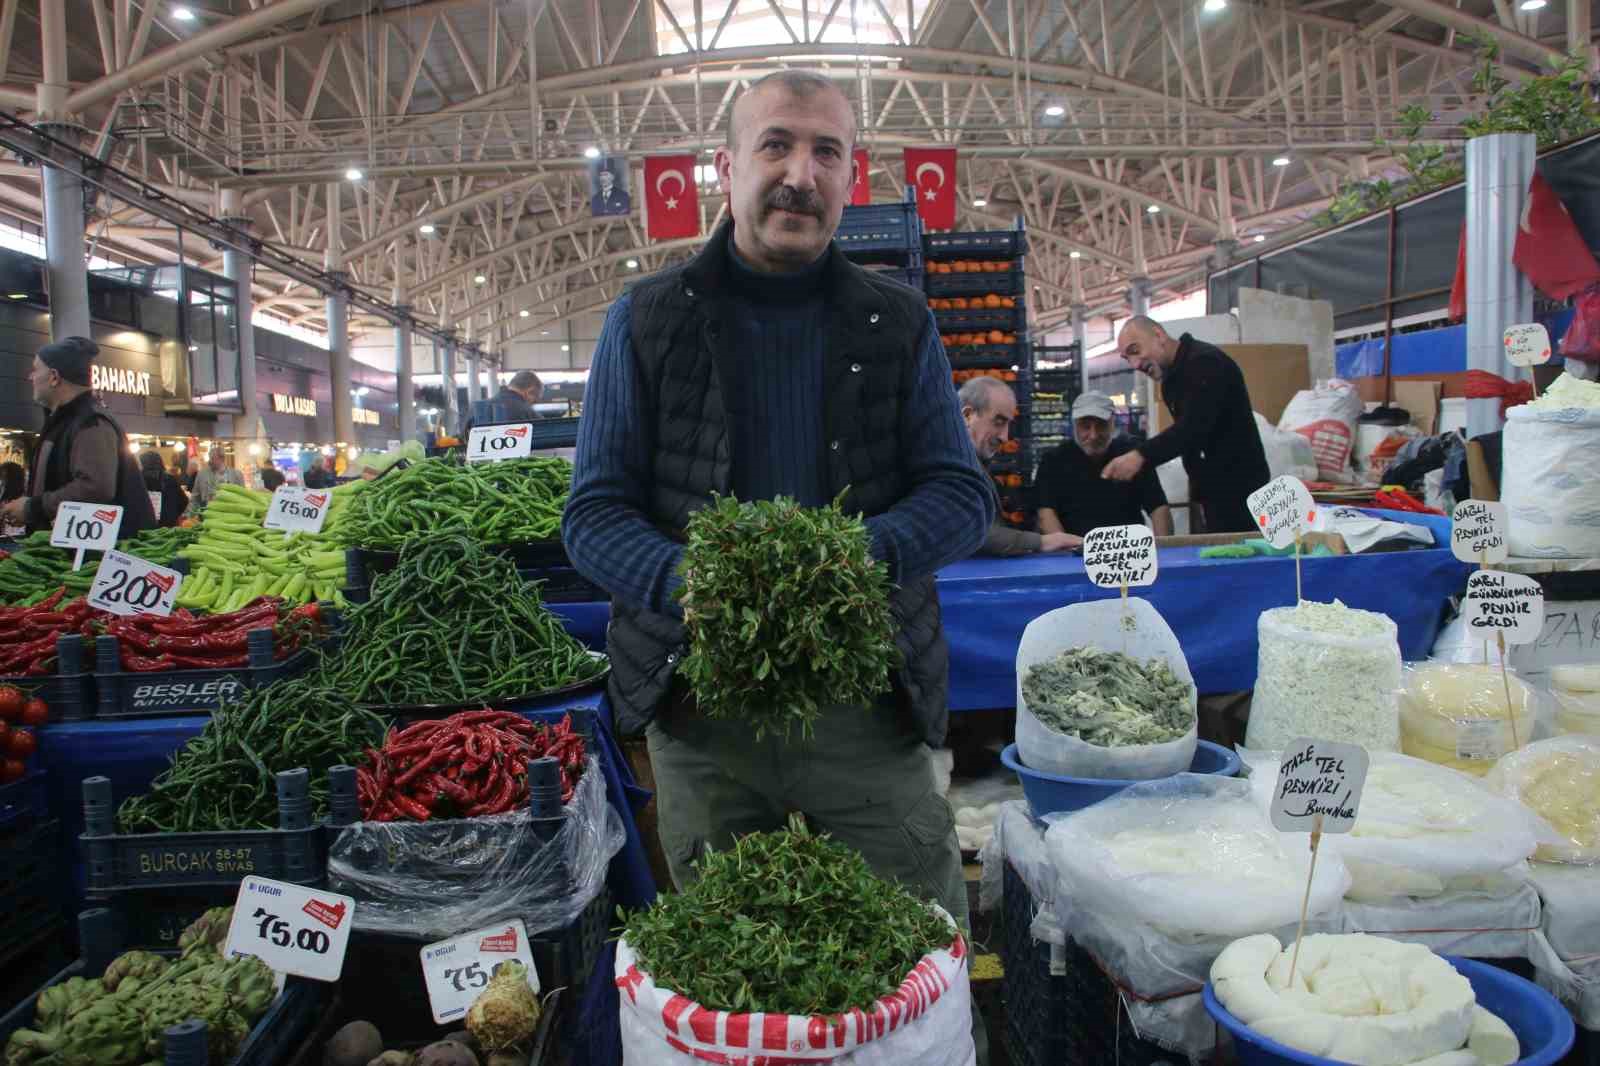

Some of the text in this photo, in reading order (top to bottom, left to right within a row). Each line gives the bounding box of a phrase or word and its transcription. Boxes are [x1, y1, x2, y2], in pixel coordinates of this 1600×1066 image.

[91, 364, 150, 396] BAHARAT
[480, 435, 517, 453] 100
[65, 514, 103, 541] 100
[1088, 536, 1153, 554] ERZURUM
[1479, 600, 1531, 616] PEYNİR
[1280, 744, 1345, 777] TAZE TEL
[252, 906, 330, 954] 75,00
